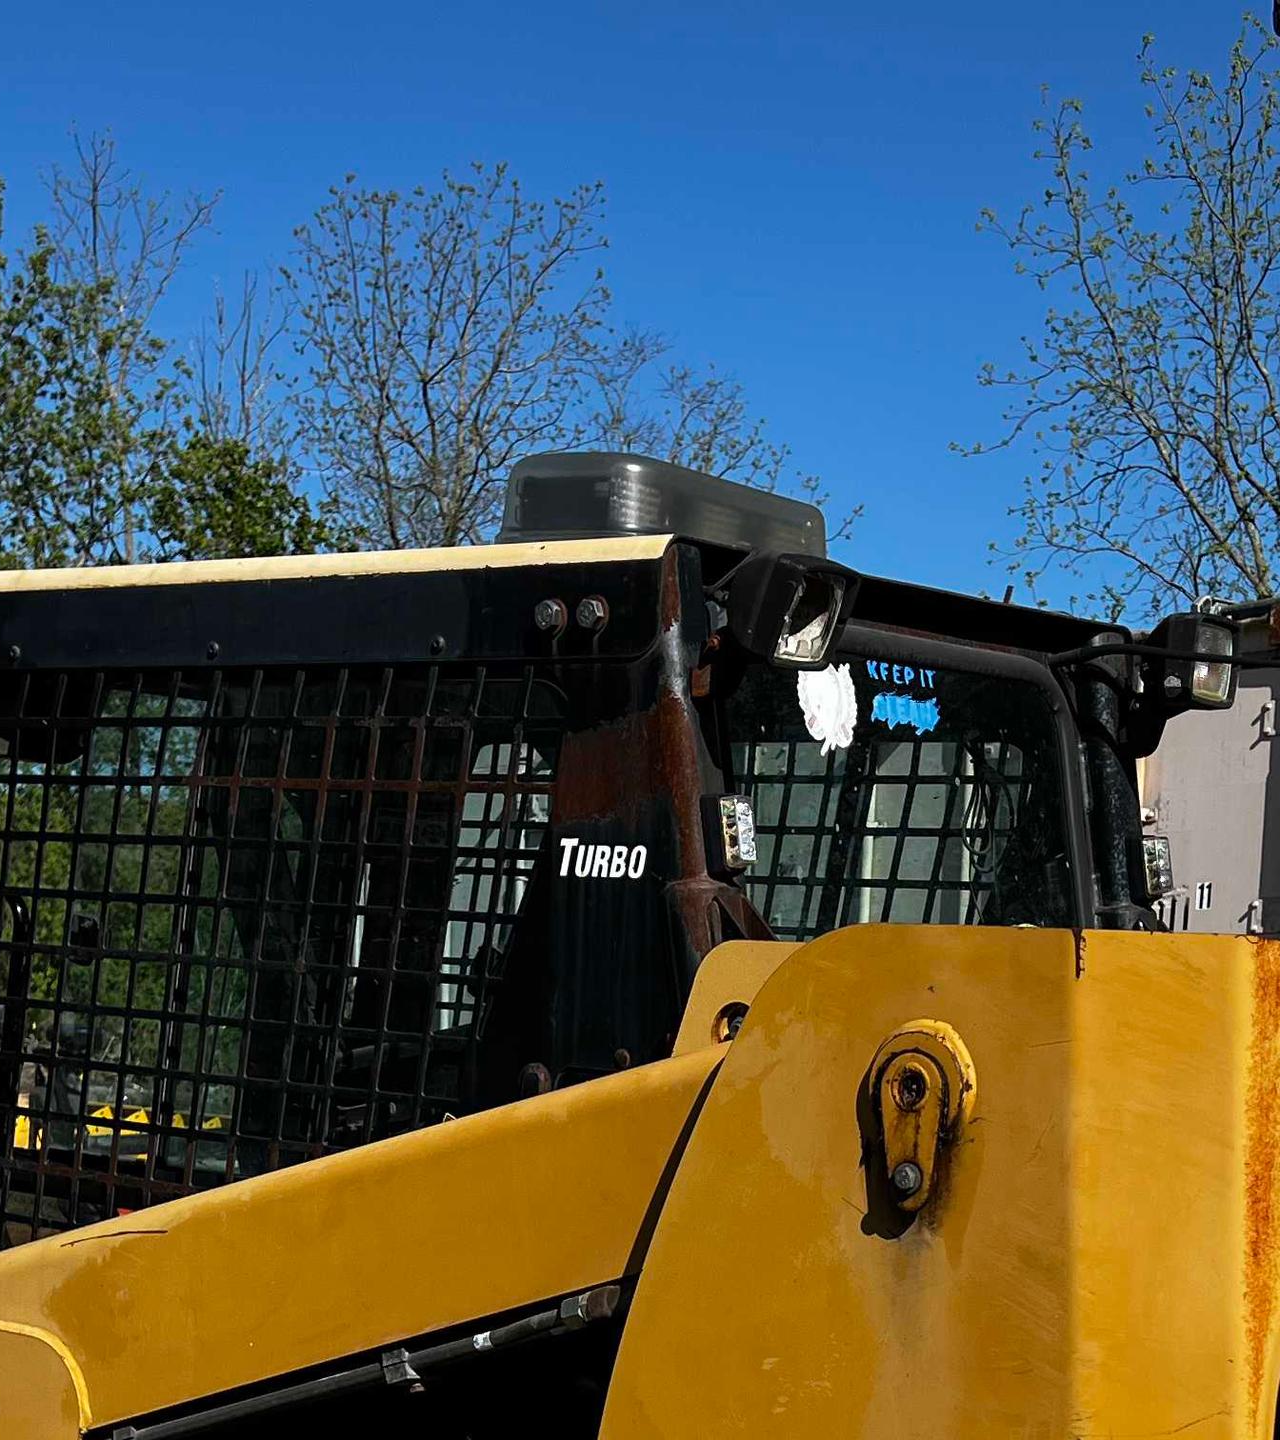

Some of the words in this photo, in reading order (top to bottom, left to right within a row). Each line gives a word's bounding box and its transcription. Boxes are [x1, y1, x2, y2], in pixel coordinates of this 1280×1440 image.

[919, 668, 936, 689] IT
[559, 837, 648, 879] TURBO
[1198, 882, 1213, 910] 11
